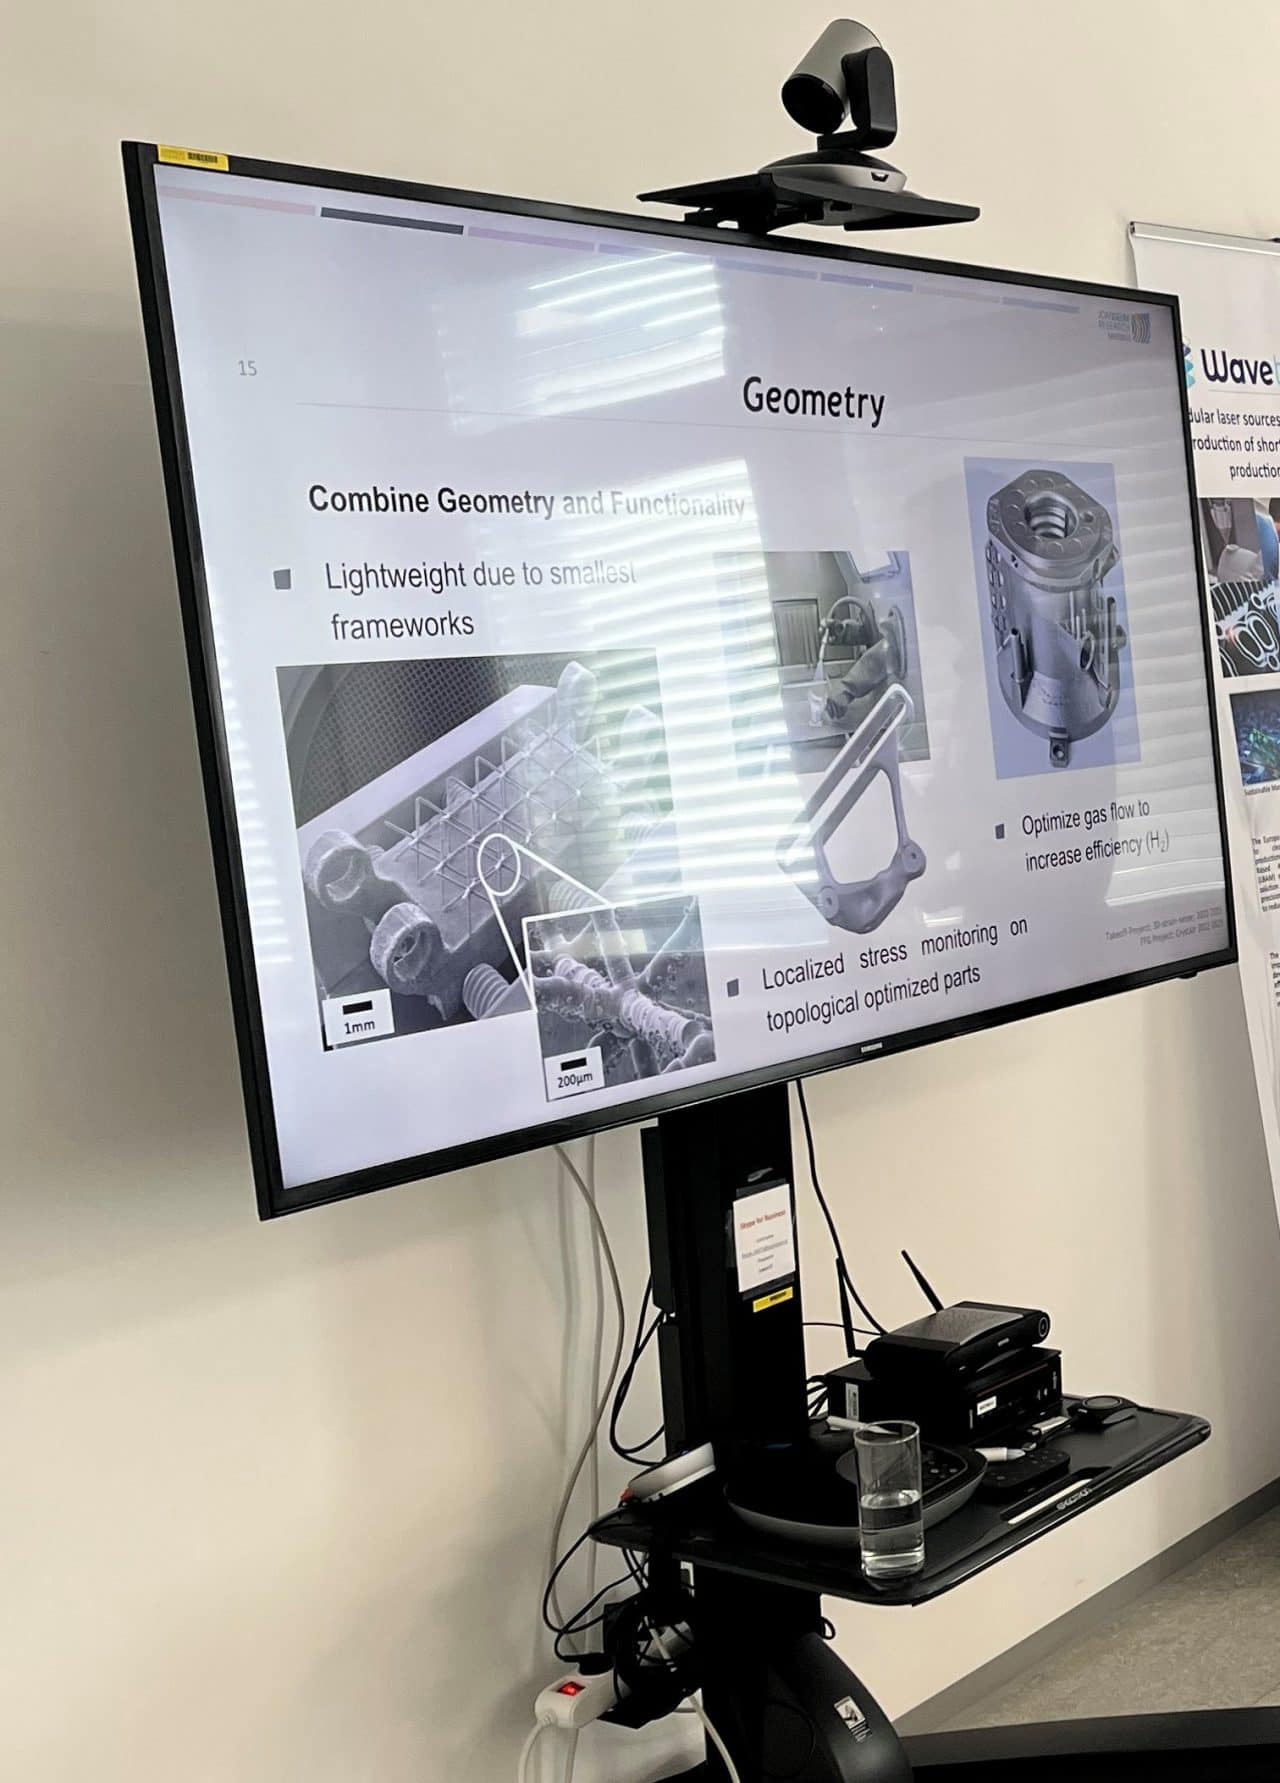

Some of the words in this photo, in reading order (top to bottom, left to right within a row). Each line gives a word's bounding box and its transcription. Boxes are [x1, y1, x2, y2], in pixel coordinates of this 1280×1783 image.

[237, 360, 257, 377] 15
[743, 376, 885, 428] Geometry
[1188, 408, 1214, 424] dular
[1217, 408, 1240, 425] laser
[1243, 414, 1280, 427] sources
[1192, 435, 1242, 451] roduction
[1244, 436, 1254, 452] of
[308, 484, 429, 514] Combine
[437, 487, 554, 520] Geometry
[562, 491, 603, 516] and
[612, 492, 746, 520] Functionality
[326, 561, 466, 593] Lightweight
[473, 563, 515, 587] due
[522, 563, 543, 586] to
[550, 561, 637, 586] smallest
[330, 610, 474, 641] frameworks
[1022, 810, 1081, 838] Optimize
[1084, 807, 1107, 830] gas
[1110, 802, 1135, 821] flow
[1138, 800, 1150, 817] to
[1025, 847, 1082, 872] increase
[1085, 838, 1142, 861] efficiency
[762, 953, 845, 990] Localized
[859, 944, 907, 969] stress
[921, 924, 998, 956] monitoring
[1010, 918, 1028, 936] on
[767, 991, 860, 1034] topological
[864, 974, 939, 1011] optimized
[944, 965, 981, 993] parts
[345, 1019, 375, 1035] 1mm
